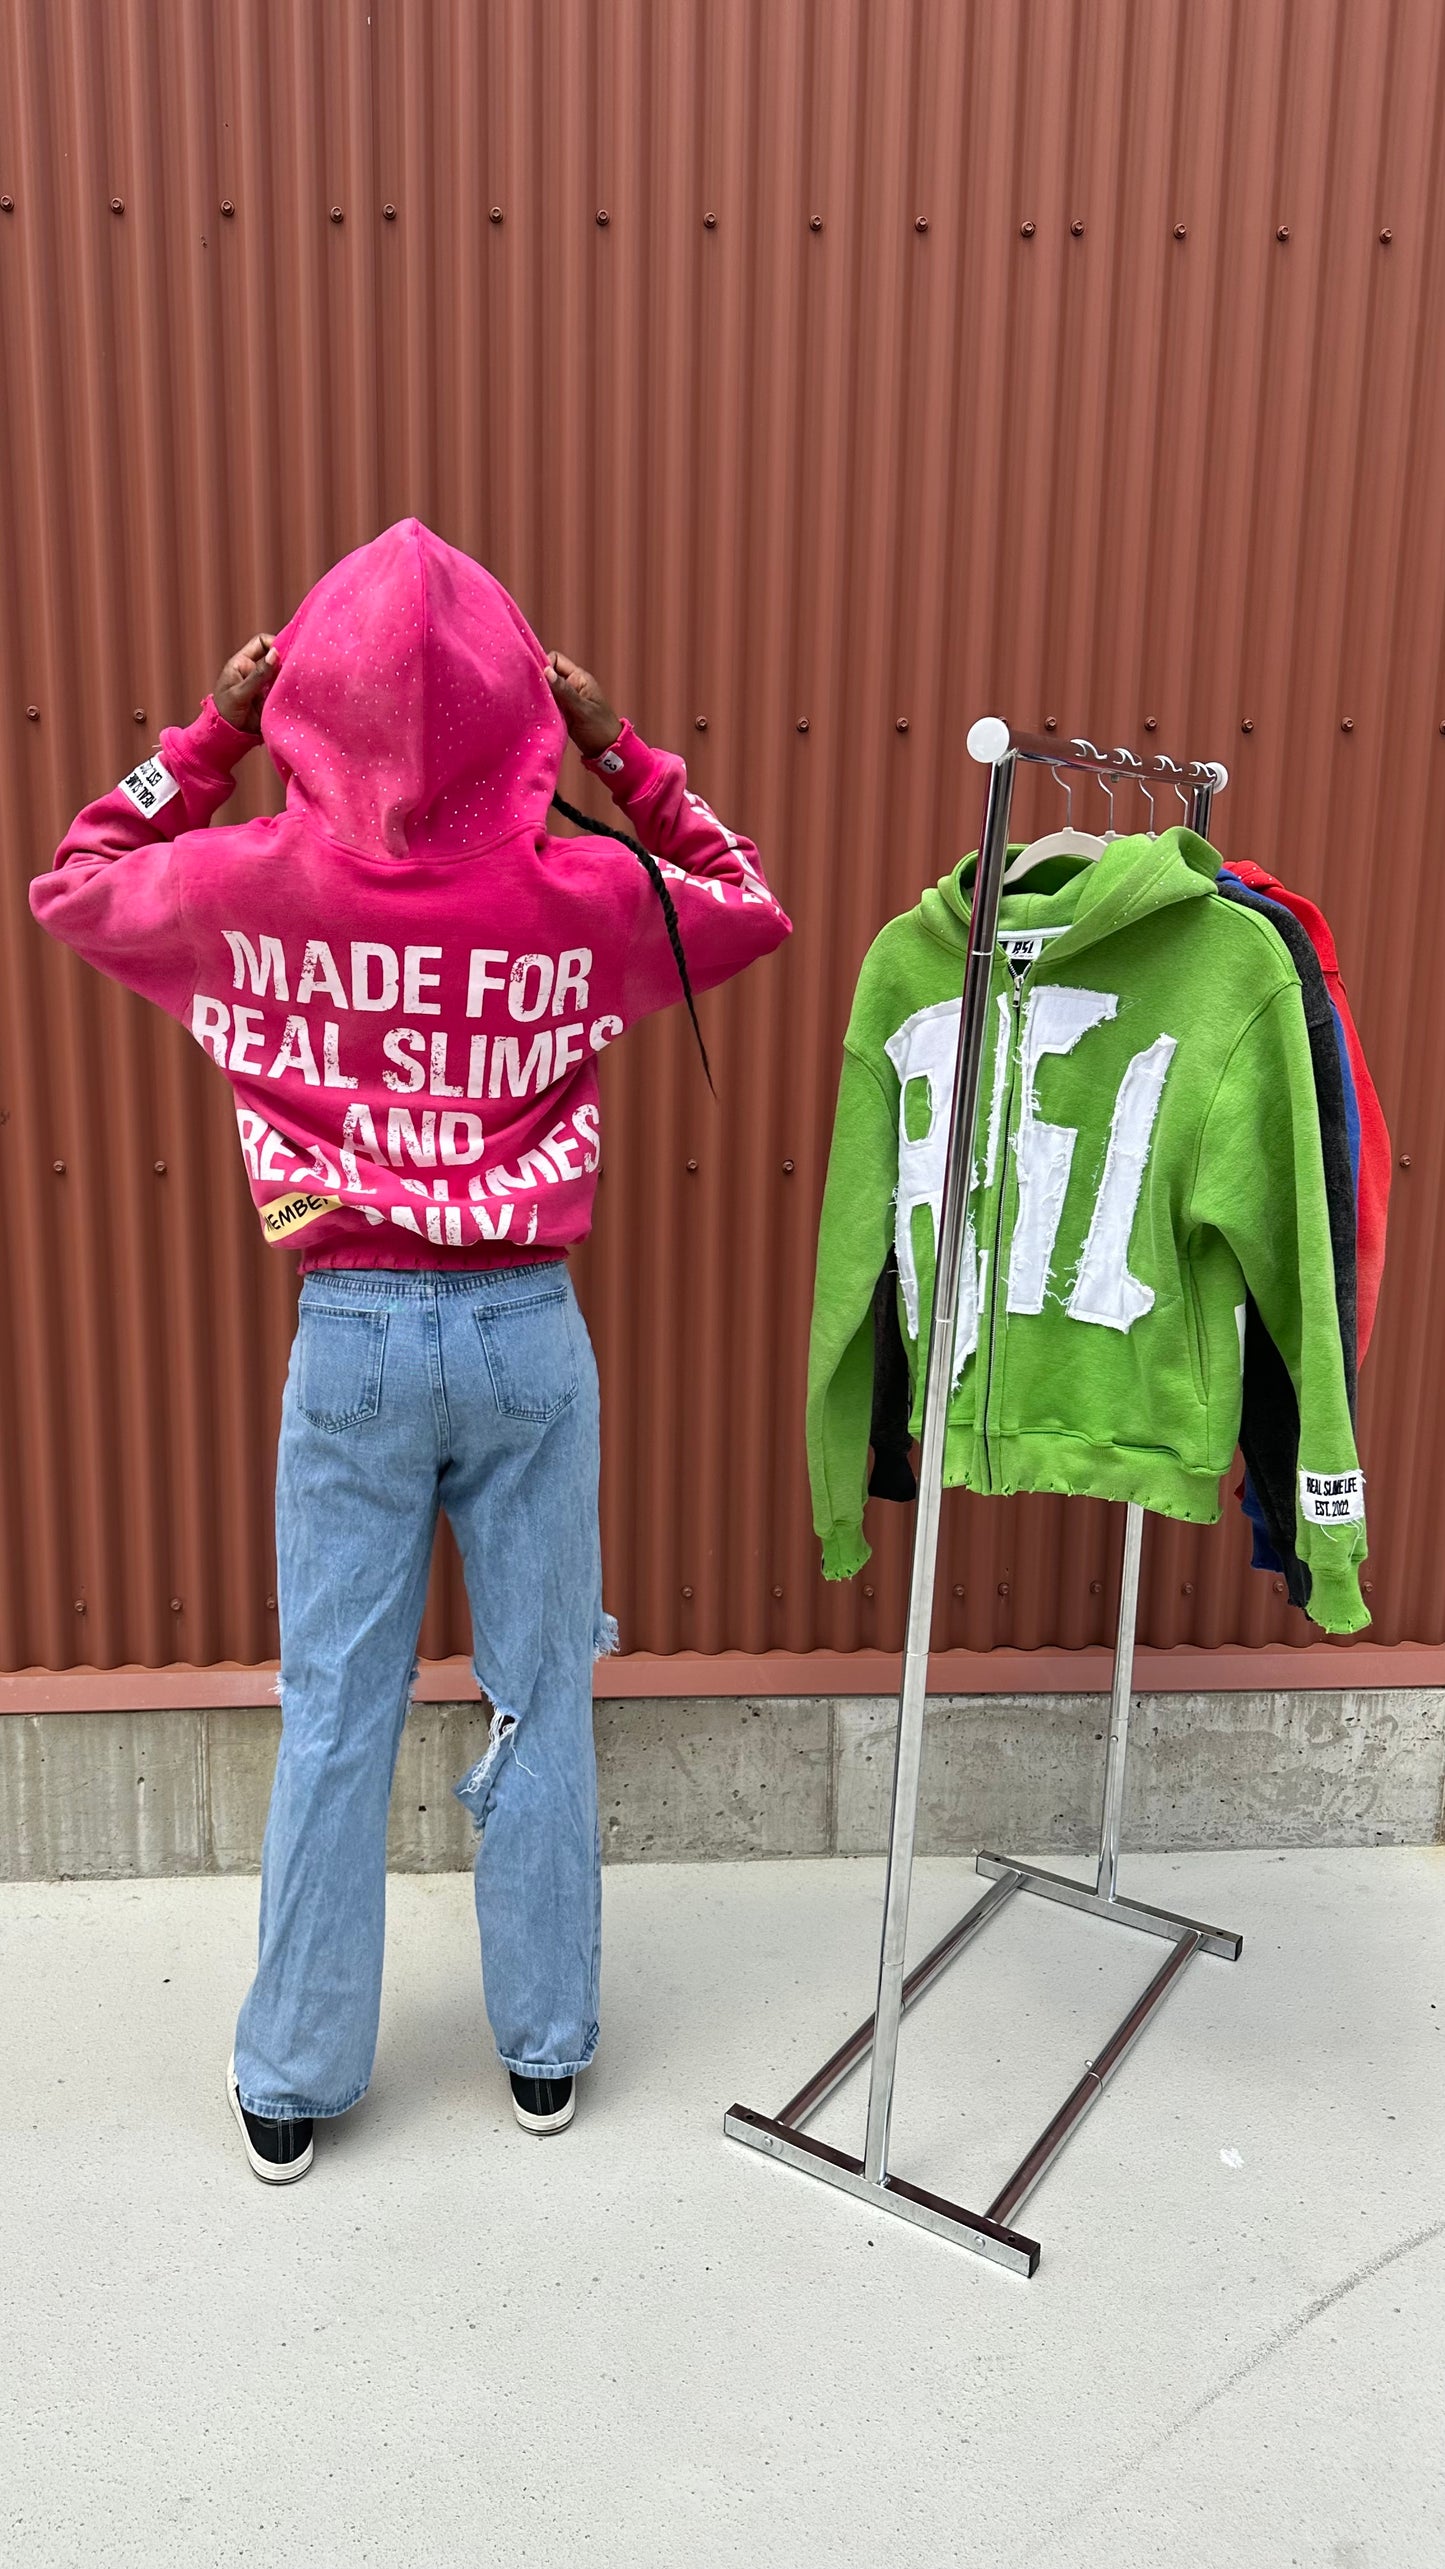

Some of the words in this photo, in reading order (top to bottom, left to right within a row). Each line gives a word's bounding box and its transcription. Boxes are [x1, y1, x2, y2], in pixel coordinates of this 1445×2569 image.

[603, 758, 617, 772] 3
[136, 786, 157, 809] REAL
[221, 929, 442, 1015] MADE
[465, 947, 593, 1022] FOR
[192, 993, 359, 1088] REAL
[381, 1014, 625, 1098] SLIMES
[236, 1108, 378, 1195] REAL
[342, 1102, 486, 1168] AND
[1306, 1476, 1322, 1496] REAL
[1323, 1478, 1344, 1497] SLIME
[1344, 1476, 1358, 1493] LIFE
[1314, 1499, 1331, 1517] EST.
[1331, 1498, 1350, 1517] 2022
